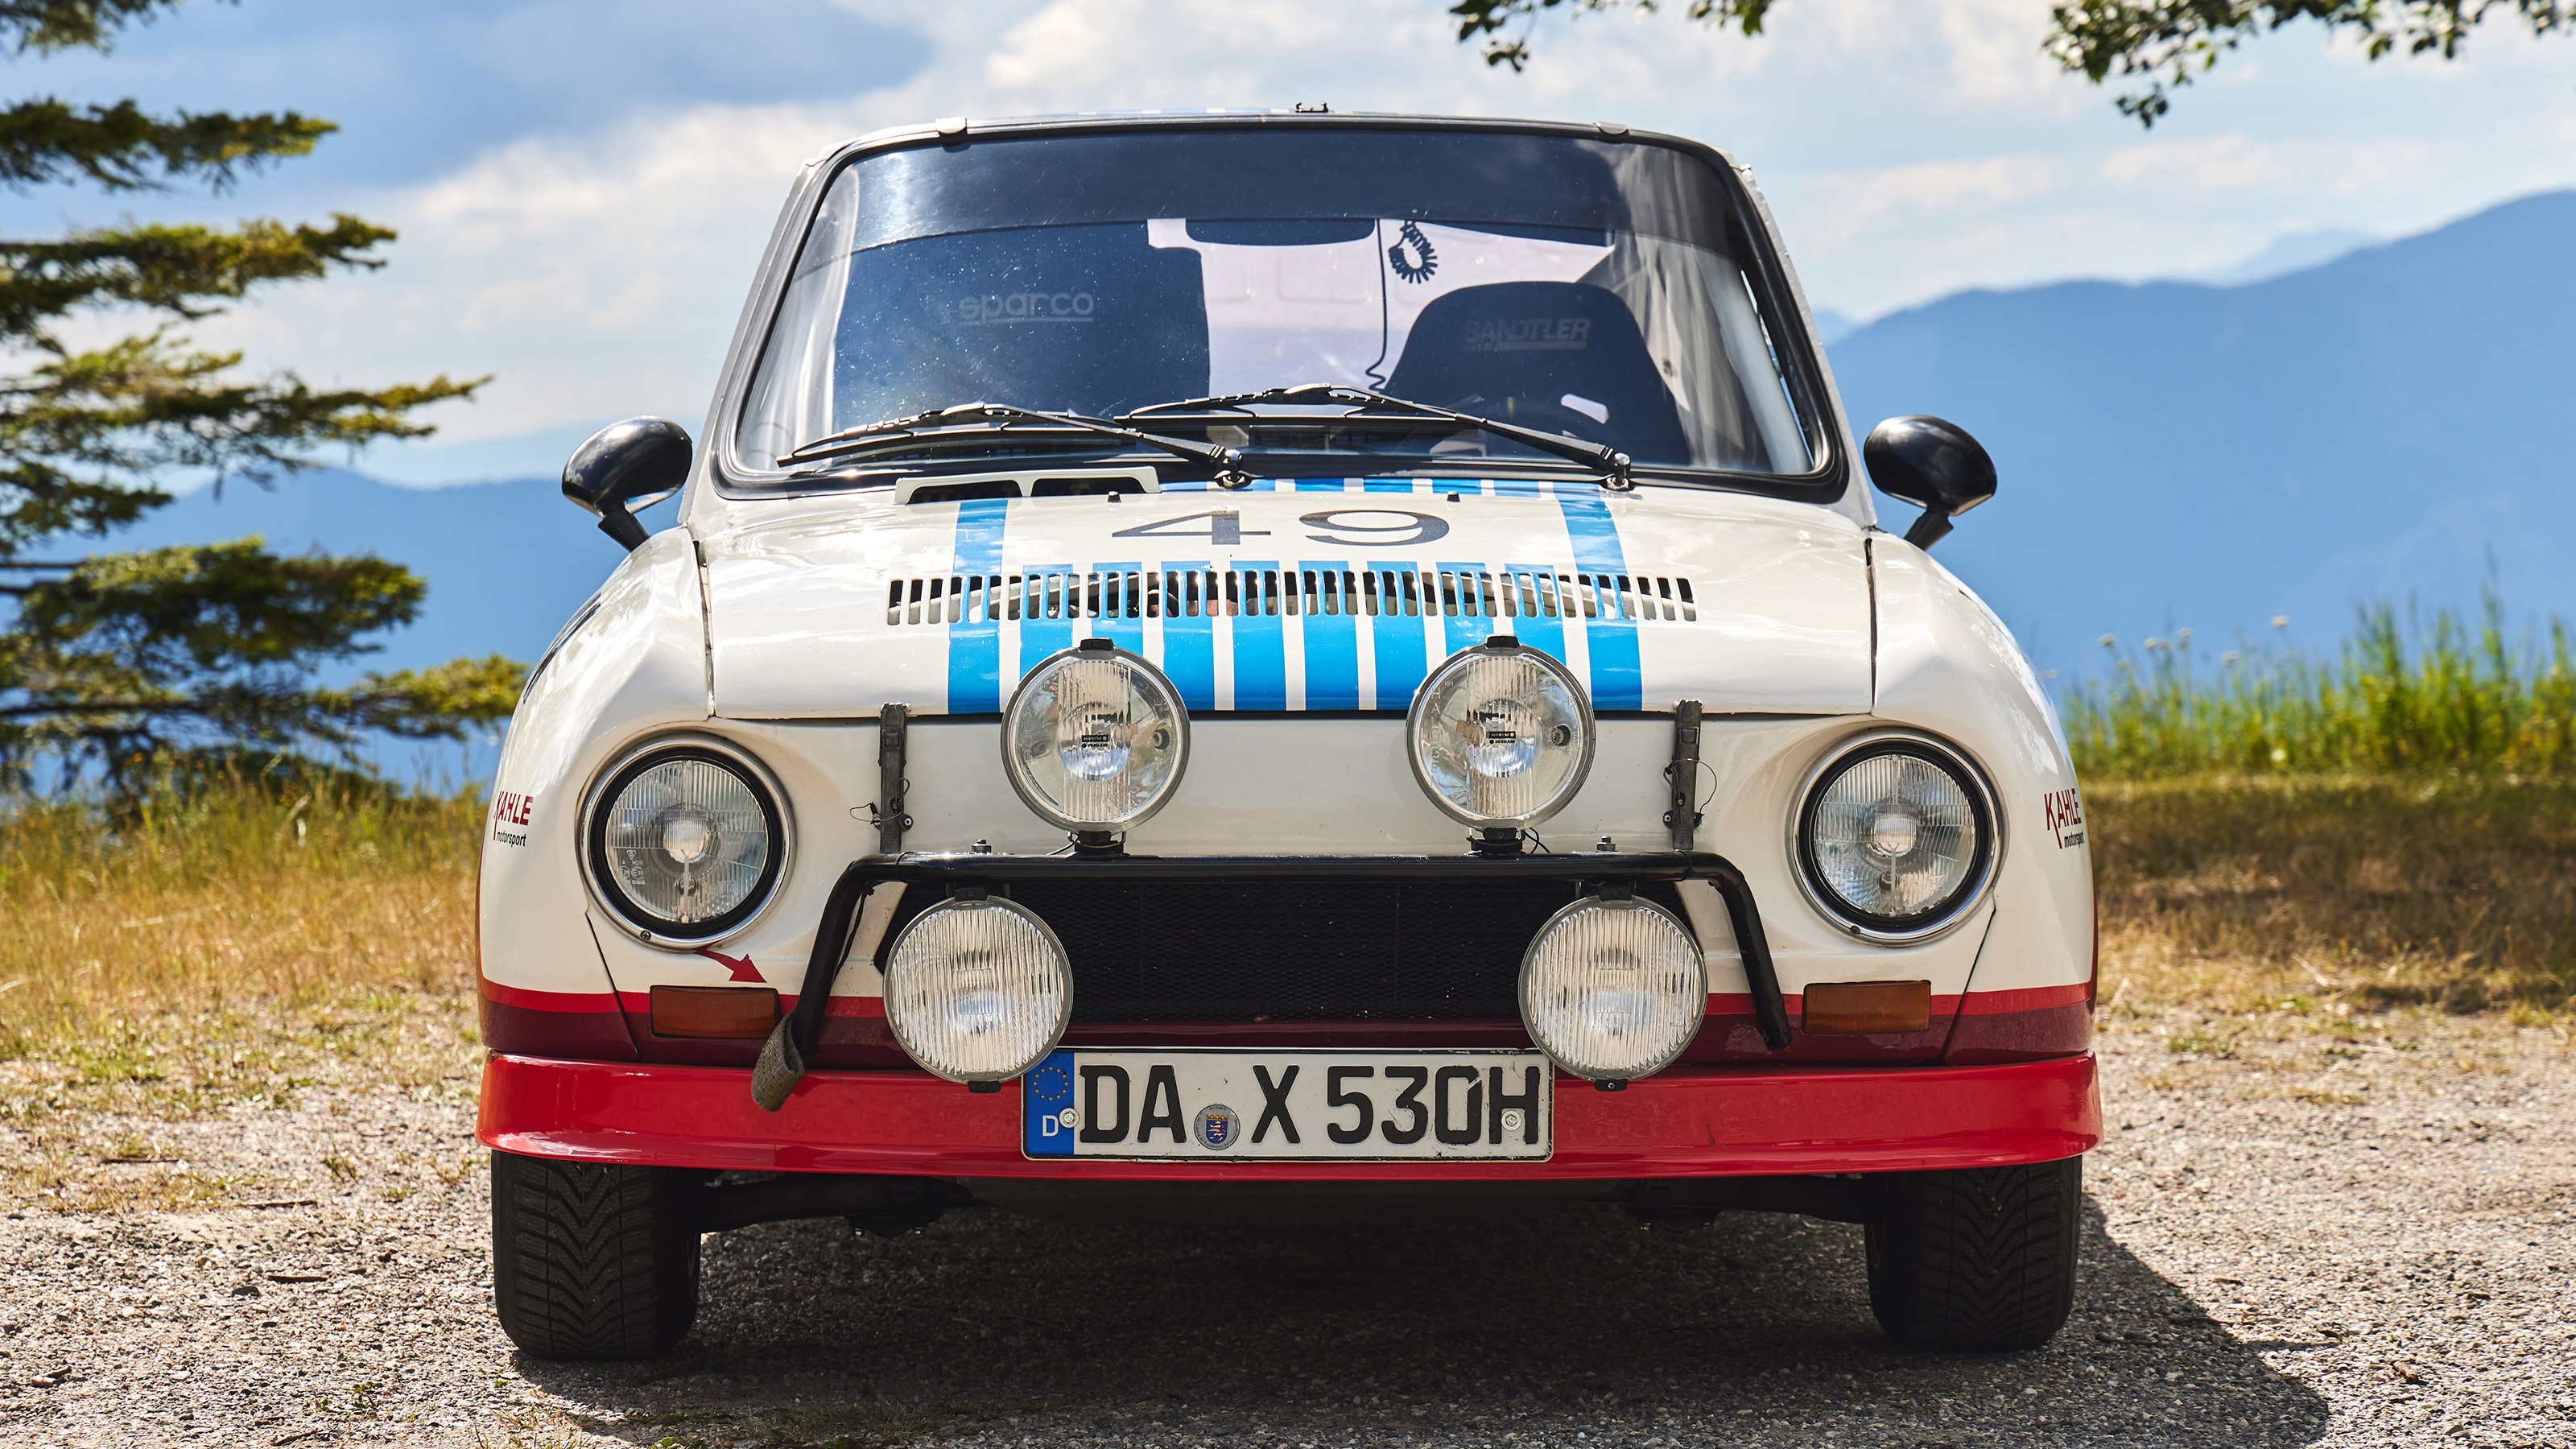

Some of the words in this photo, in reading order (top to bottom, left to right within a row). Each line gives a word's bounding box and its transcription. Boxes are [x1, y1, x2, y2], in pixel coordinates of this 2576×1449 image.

[958, 292, 1094, 325] sparco
[1112, 509, 1450, 547] 49
[493, 791, 535, 840] KAHLE
[2044, 788, 2082, 849] KAHLE
[497, 830, 526, 848] motorsport
[1080, 1064, 1187, 1144] DA
[1250, 1064, 1300, 1144] X
[1327, 1064, 1541, 1146] 530H
[1042, 1115, 1059, 1137] D
